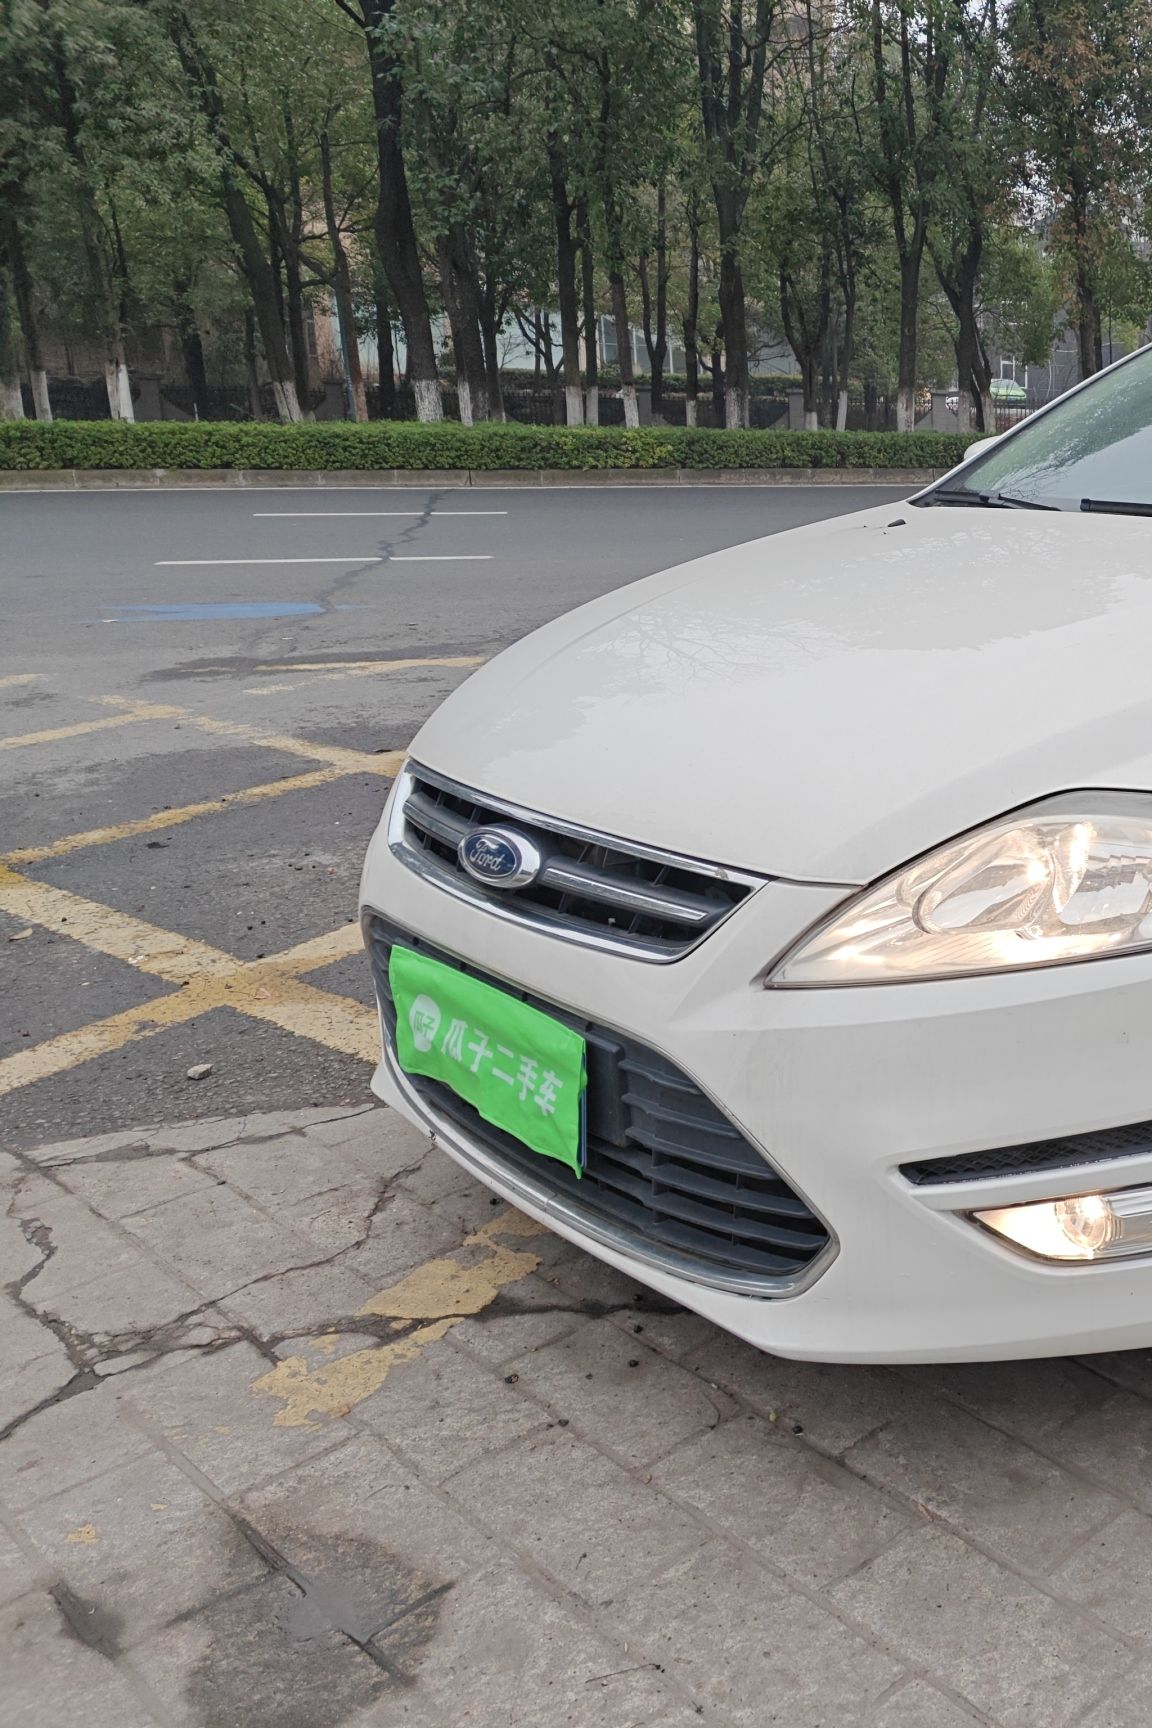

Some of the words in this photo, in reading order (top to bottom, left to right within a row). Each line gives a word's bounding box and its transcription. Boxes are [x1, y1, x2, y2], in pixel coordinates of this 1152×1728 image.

[469, 838, 506, 871] Ford
[441, 1018, 563, 1117] 瓜子二手车
